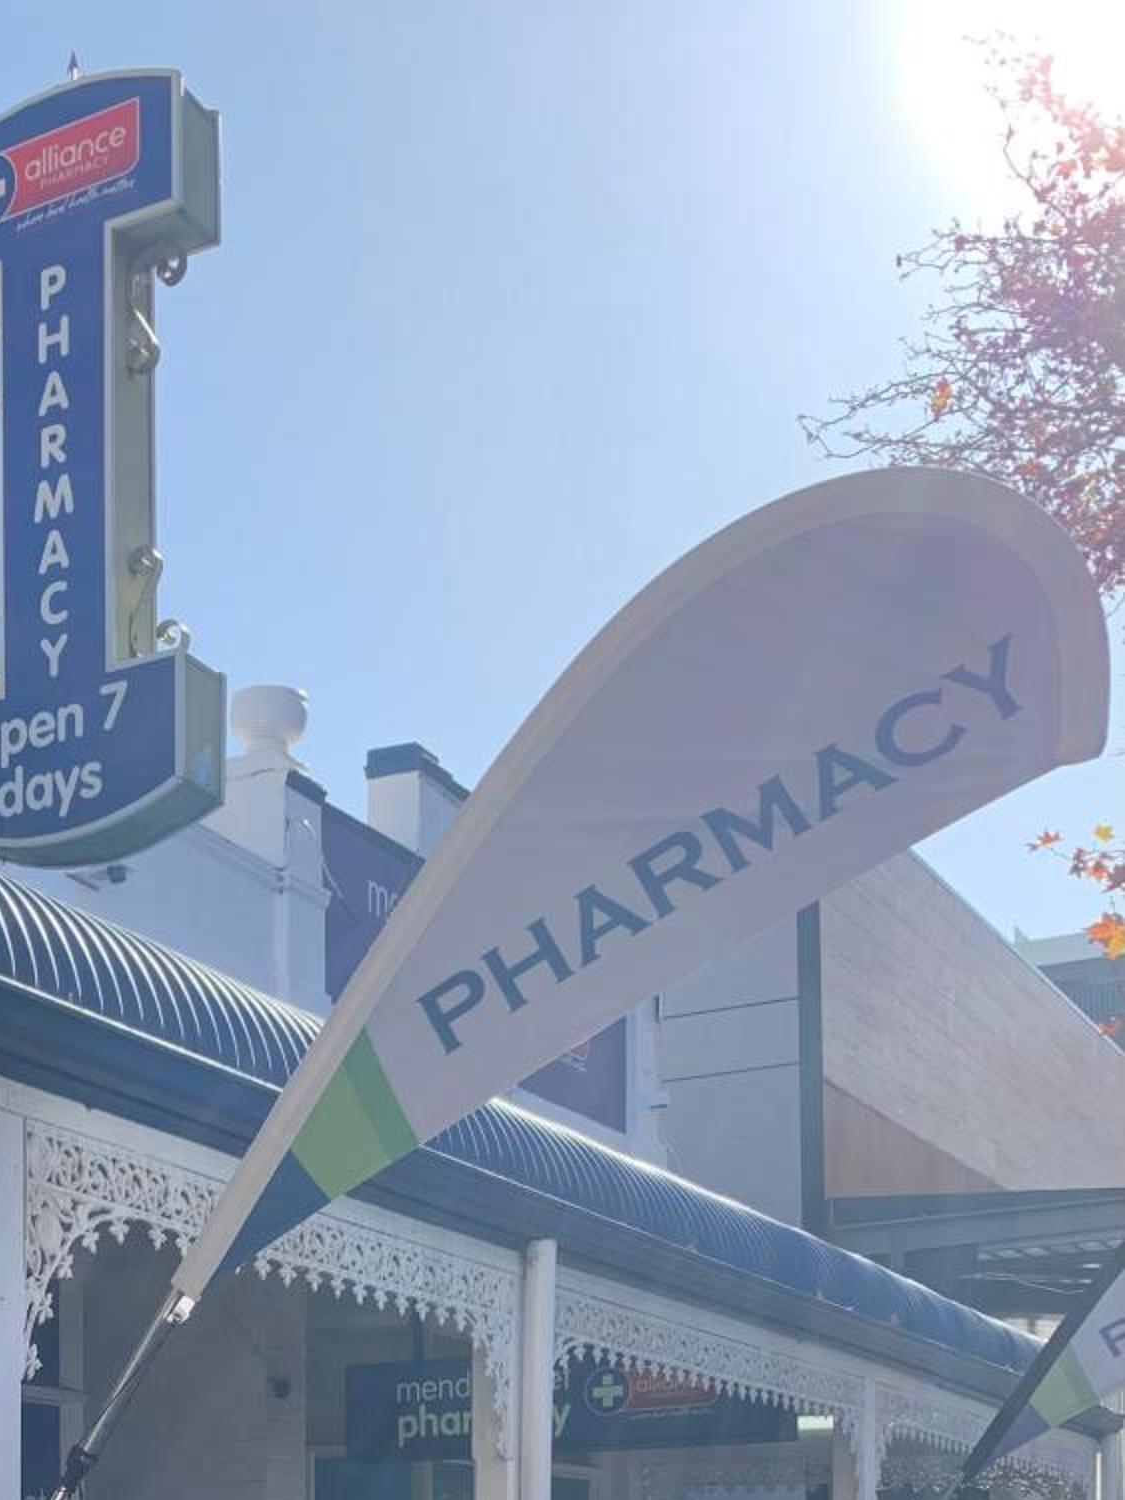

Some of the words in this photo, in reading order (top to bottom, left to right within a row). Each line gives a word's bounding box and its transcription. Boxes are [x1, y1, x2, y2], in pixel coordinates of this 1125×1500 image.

[24, 126, 126, 181] alliance
[34, 264, 74, 678] PHARMACY
[99, 680, 129, 732] 7
[416, 633, 1025, 1057] PHARMACY
[396, 1368, 472, 1404] mend
